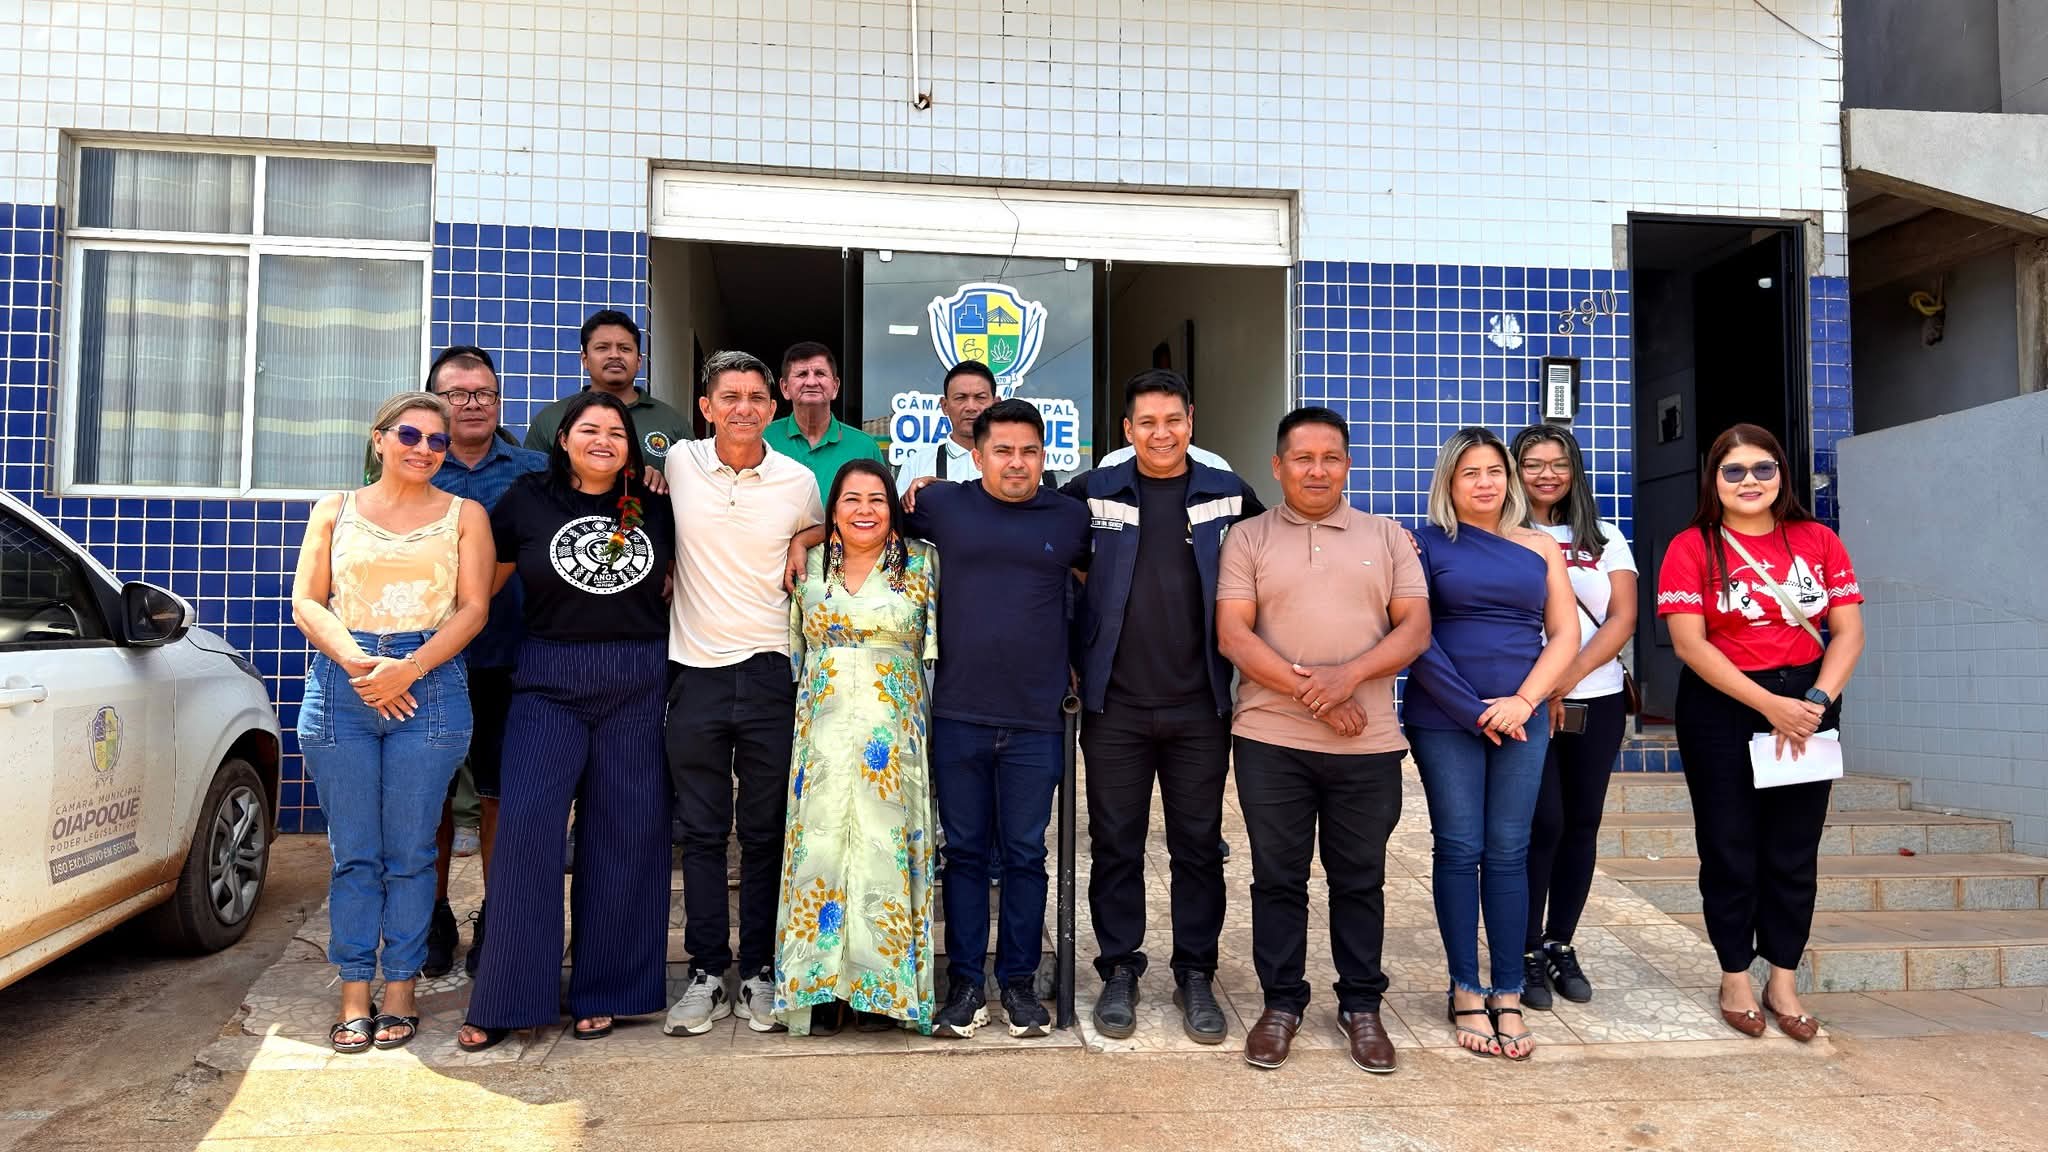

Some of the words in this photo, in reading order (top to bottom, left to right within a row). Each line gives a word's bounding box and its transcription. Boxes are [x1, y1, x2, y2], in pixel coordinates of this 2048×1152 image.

[1559, 289, 1617, 335] 390
[99, 785, 141, 803] MUNICIPAL
[52, 797, 139, 840] OIAPOQUE
[50, 838, 80, 854] PODER
[84, 819, 136, 843] LEGISLATIVO
[53, 862, 68, 876] USO
[104, 847, 112, 858] EM
